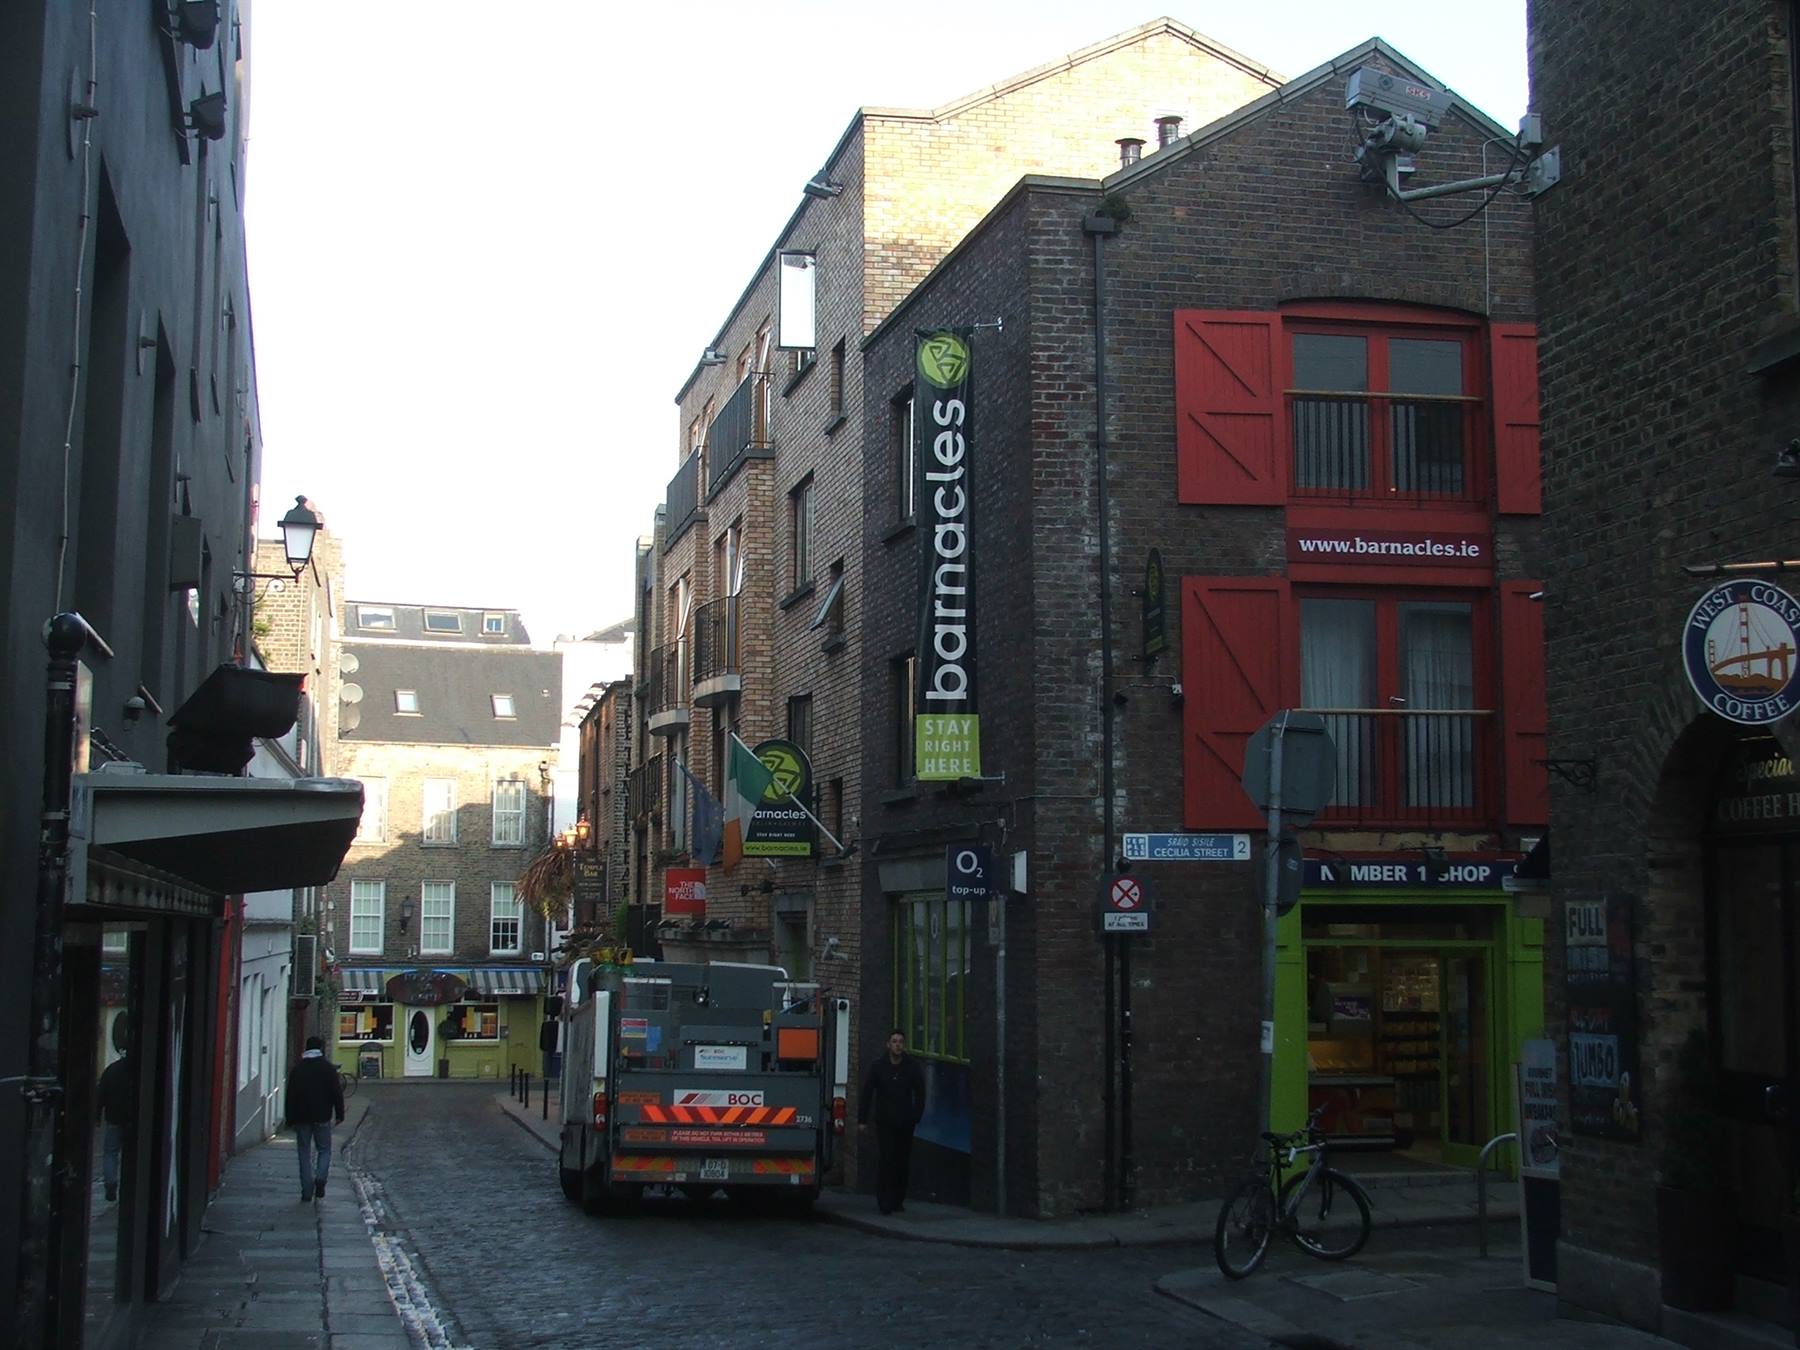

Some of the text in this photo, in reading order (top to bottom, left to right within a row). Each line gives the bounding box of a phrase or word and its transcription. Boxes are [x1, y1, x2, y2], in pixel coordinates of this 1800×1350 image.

[925, 399, 967, 700] barnacles
[1299, 537, 1480, 557] www.barnacles.ie
[1691, 587, 1734, 631] WEST
[1713, 693, 1791, 720] COFFEE
[925, 719, 973, 736] STAY
[925, 740, 970, 752] RIGHT
[925, 758, 971, 773] HERE
[753, 809, 807, 819] arnacles
[1153, 848, 1229, 857] CECILIA STREET
[1238, 841, 1246, 853] 2
[1319, 865, 1407, 881] NMBER
[1417, 865, 1426, 881] 1
[952, 886, 986, 896] top-up
[1569, 907, 1603, 937] FULL
[1573, 1042, 1614, 1080] JUMBO
[728, 1094, 762, 1105] BOC
